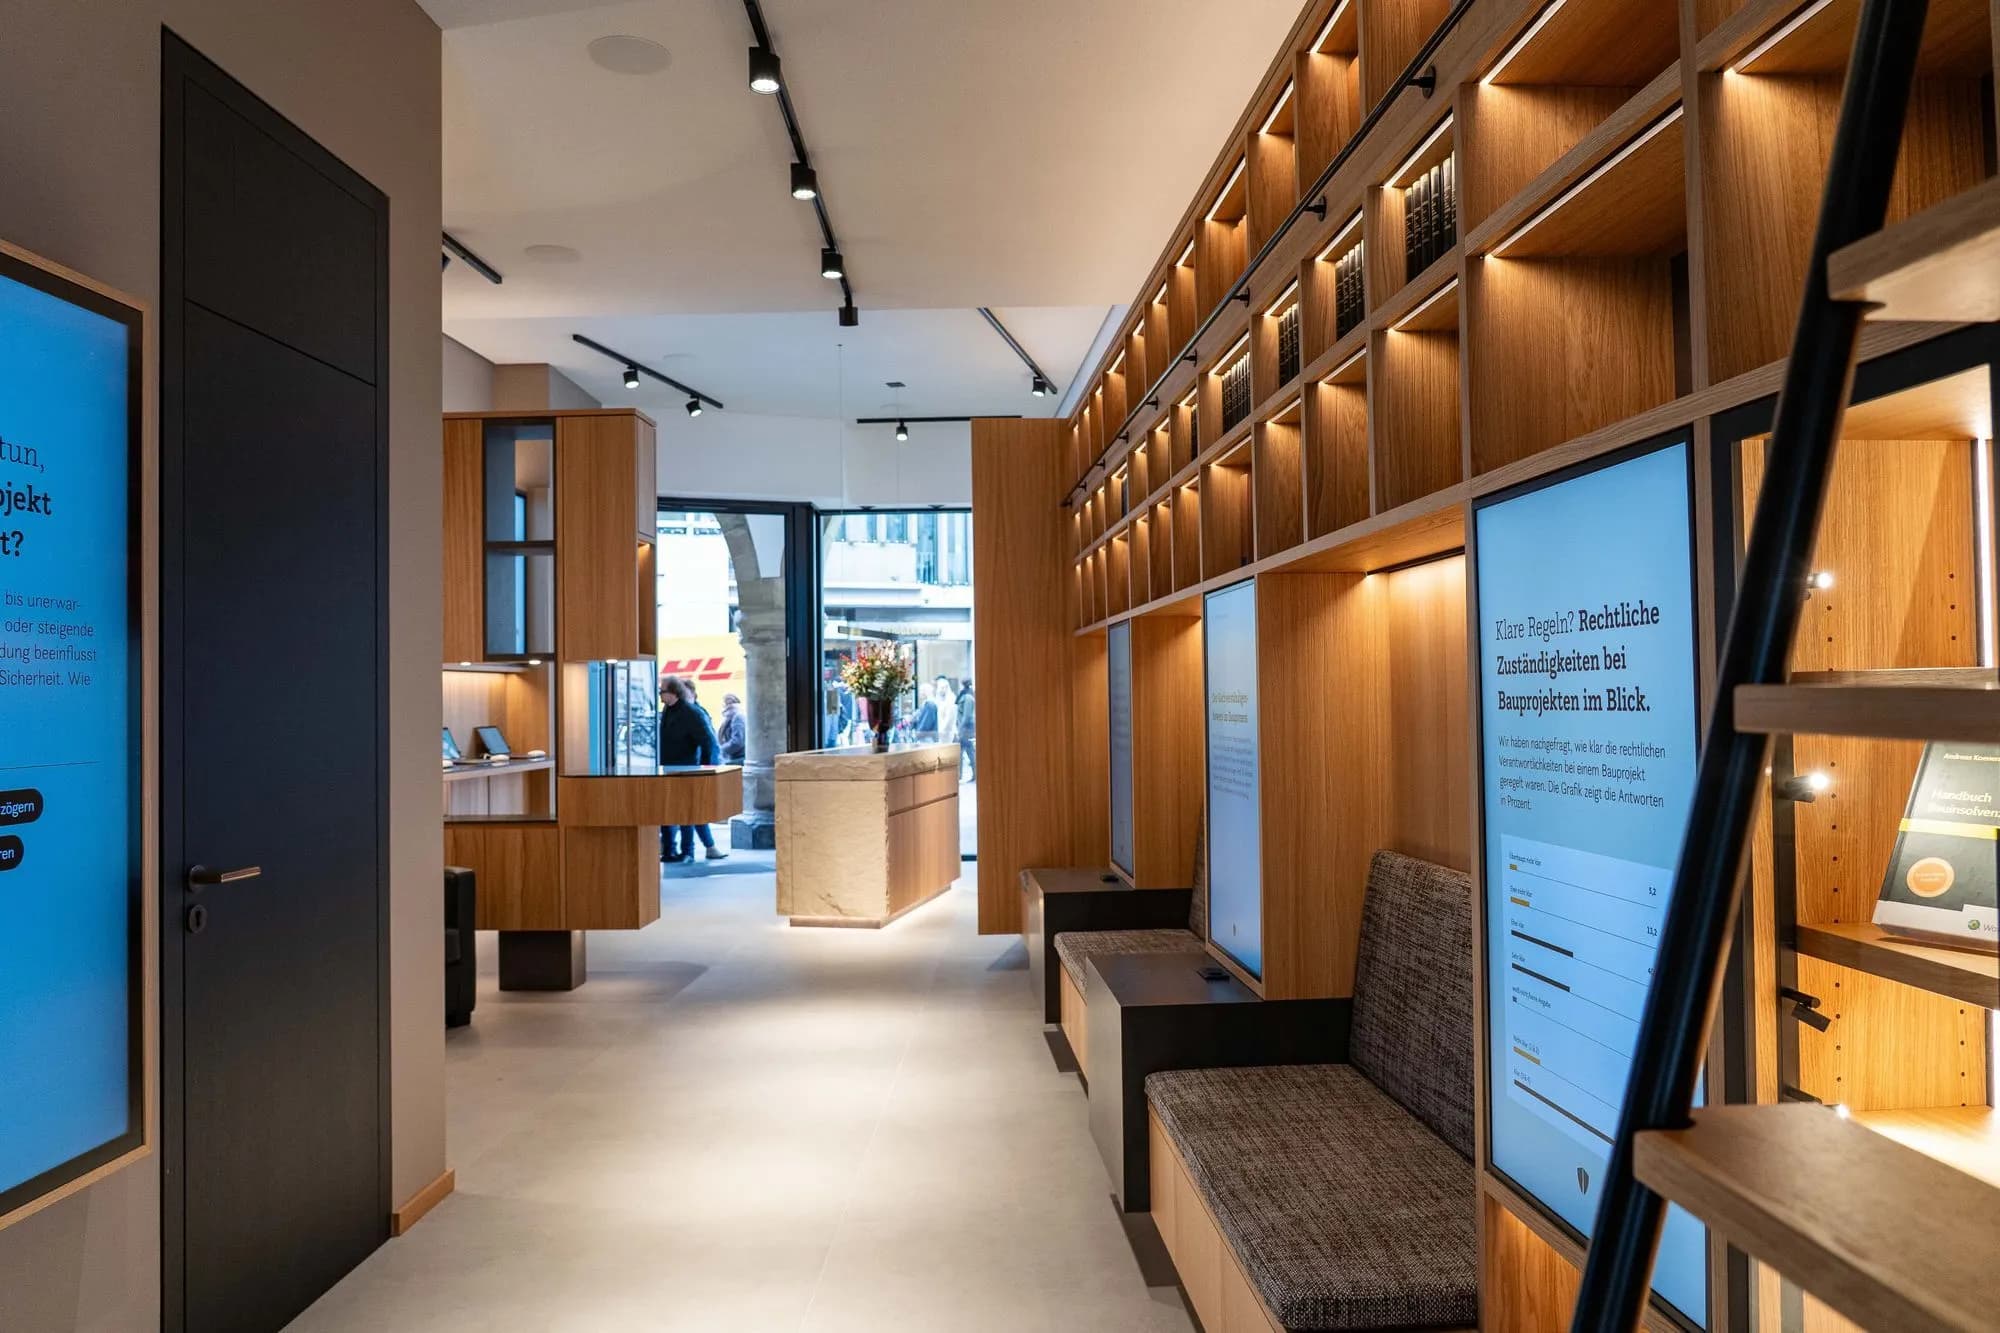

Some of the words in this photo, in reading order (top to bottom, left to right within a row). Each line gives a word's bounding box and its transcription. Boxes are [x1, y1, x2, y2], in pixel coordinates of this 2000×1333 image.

[5, 591, 24, 607] bis
[27, 596, 81, 612] unerwar-
[5, 617, 34, 633] oder
[38, 620, 94, 640] steigende
[1495, 618, 1525, 641] Klare
[1527, 610, 1575, 643] Regeln?
[1578, 599, 1660, 632] Rechtliche
[34, 643, 97, 662] beeinflusst
[1496, 649, 1600, 680] Zuständigkeiten
[1603, 645, 1627, 671] bei
[0, 669, 64, 687] Sicherheit.
[68, 671, 91, 687] Wie
[1497, 688, 1580, 717] Bauprojekten
[1583, 688, 1603, 712] im
[1606, 686, 1650, 712] Blick.
[1511, 735, 1530, 749] haben
[1531, 736, 1573, 755] nachgefragt,
[1575, 741, 1588, 753] wie
[1589, 739, 1604, 754] klar
[1605, 740, 1617, 755] die
[1619, 741, 1666, 758] rechtlichen
[1564, 760, 1576, 774] bei
[1576, 762, 1600, 777] einem
[1601, 763, 1646, 785] Bauprojekt
[1548, 780, 1560, 794] Die
[1561, 781, 1583, 797] Grafik
[1584, 785, 1602, 803] zeigt
[1604, 787, 1616, 802] die
[1618, 789, 1665, 808] Antworten
